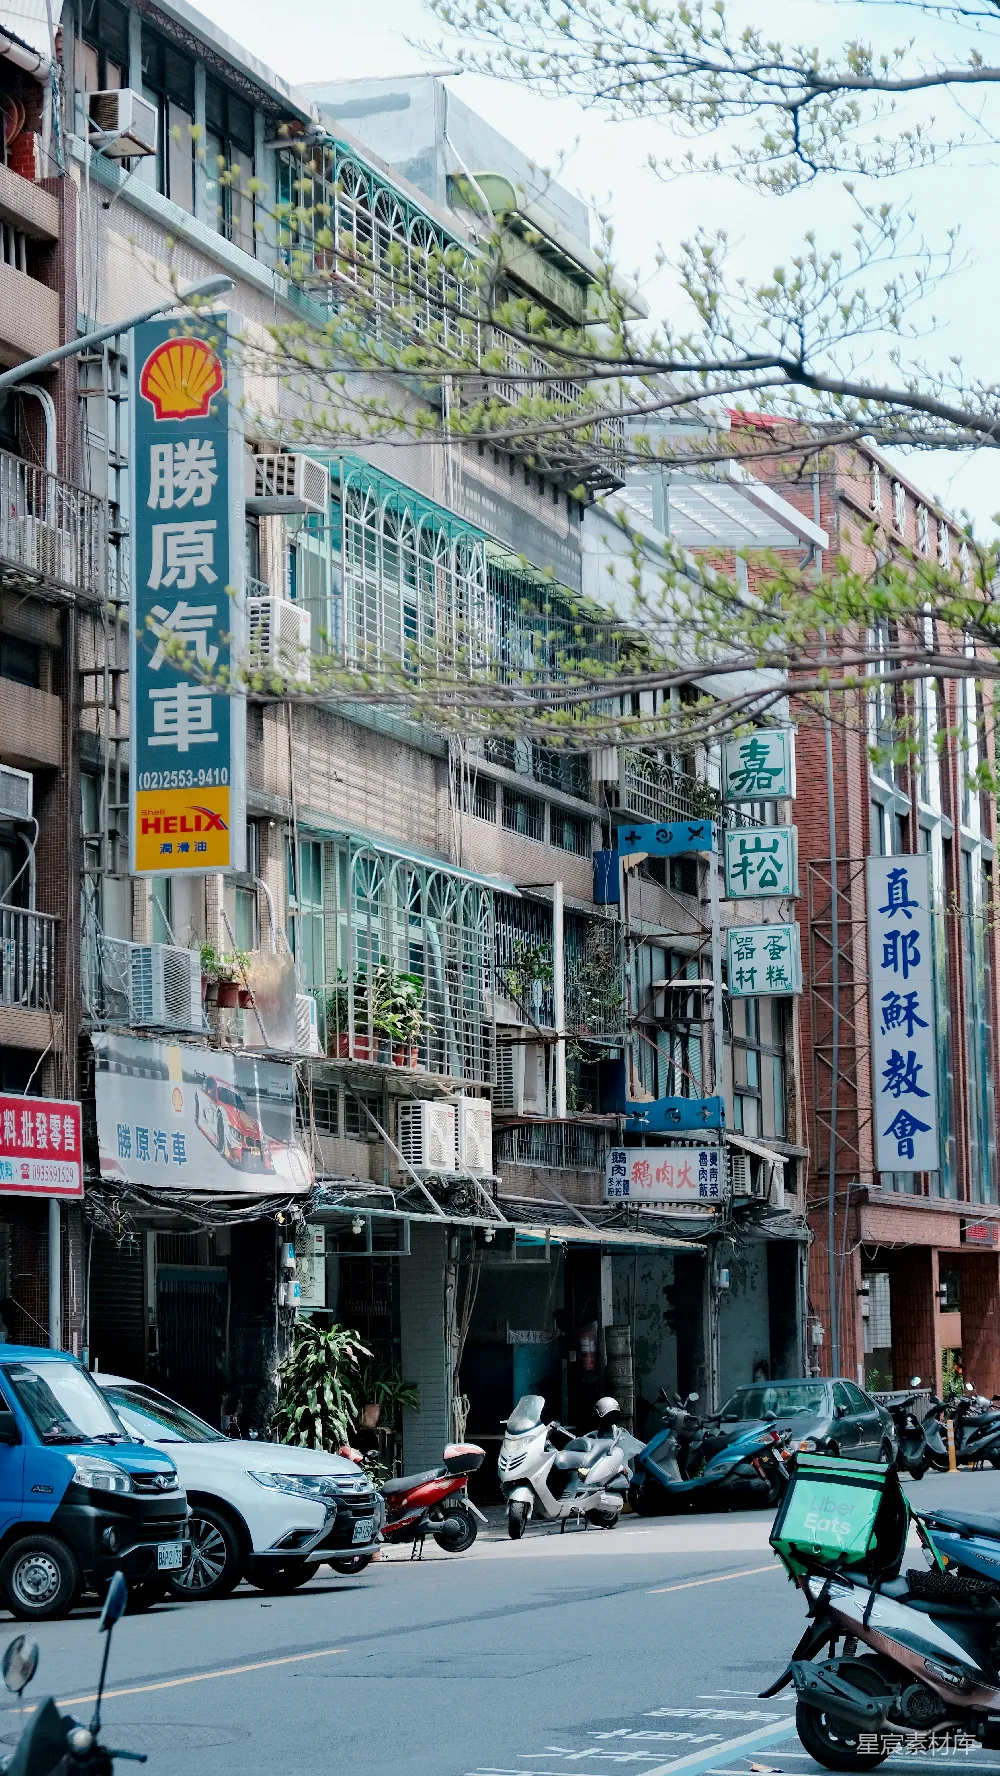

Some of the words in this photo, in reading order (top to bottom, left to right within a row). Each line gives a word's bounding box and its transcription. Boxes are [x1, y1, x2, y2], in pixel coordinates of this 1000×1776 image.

[147, 438, 219, 752] 勝原汽車
[138, 767, 228, 789] (02)2553-9410
[729, 738, 783, 793] 嘉
[141, 806, 228, 835] HELIX
[160, 841, 207, 854] 潤滑油
[878, 868, 932, 1160] 真耶穌教會
[0, 1109, 75, 1151] 料.批發零售
[116, 1123, 188, 1166] 勝原汽車
[804, 1512, 852, 1535] Eats
[811, 1496, 857, 1516] Uber
